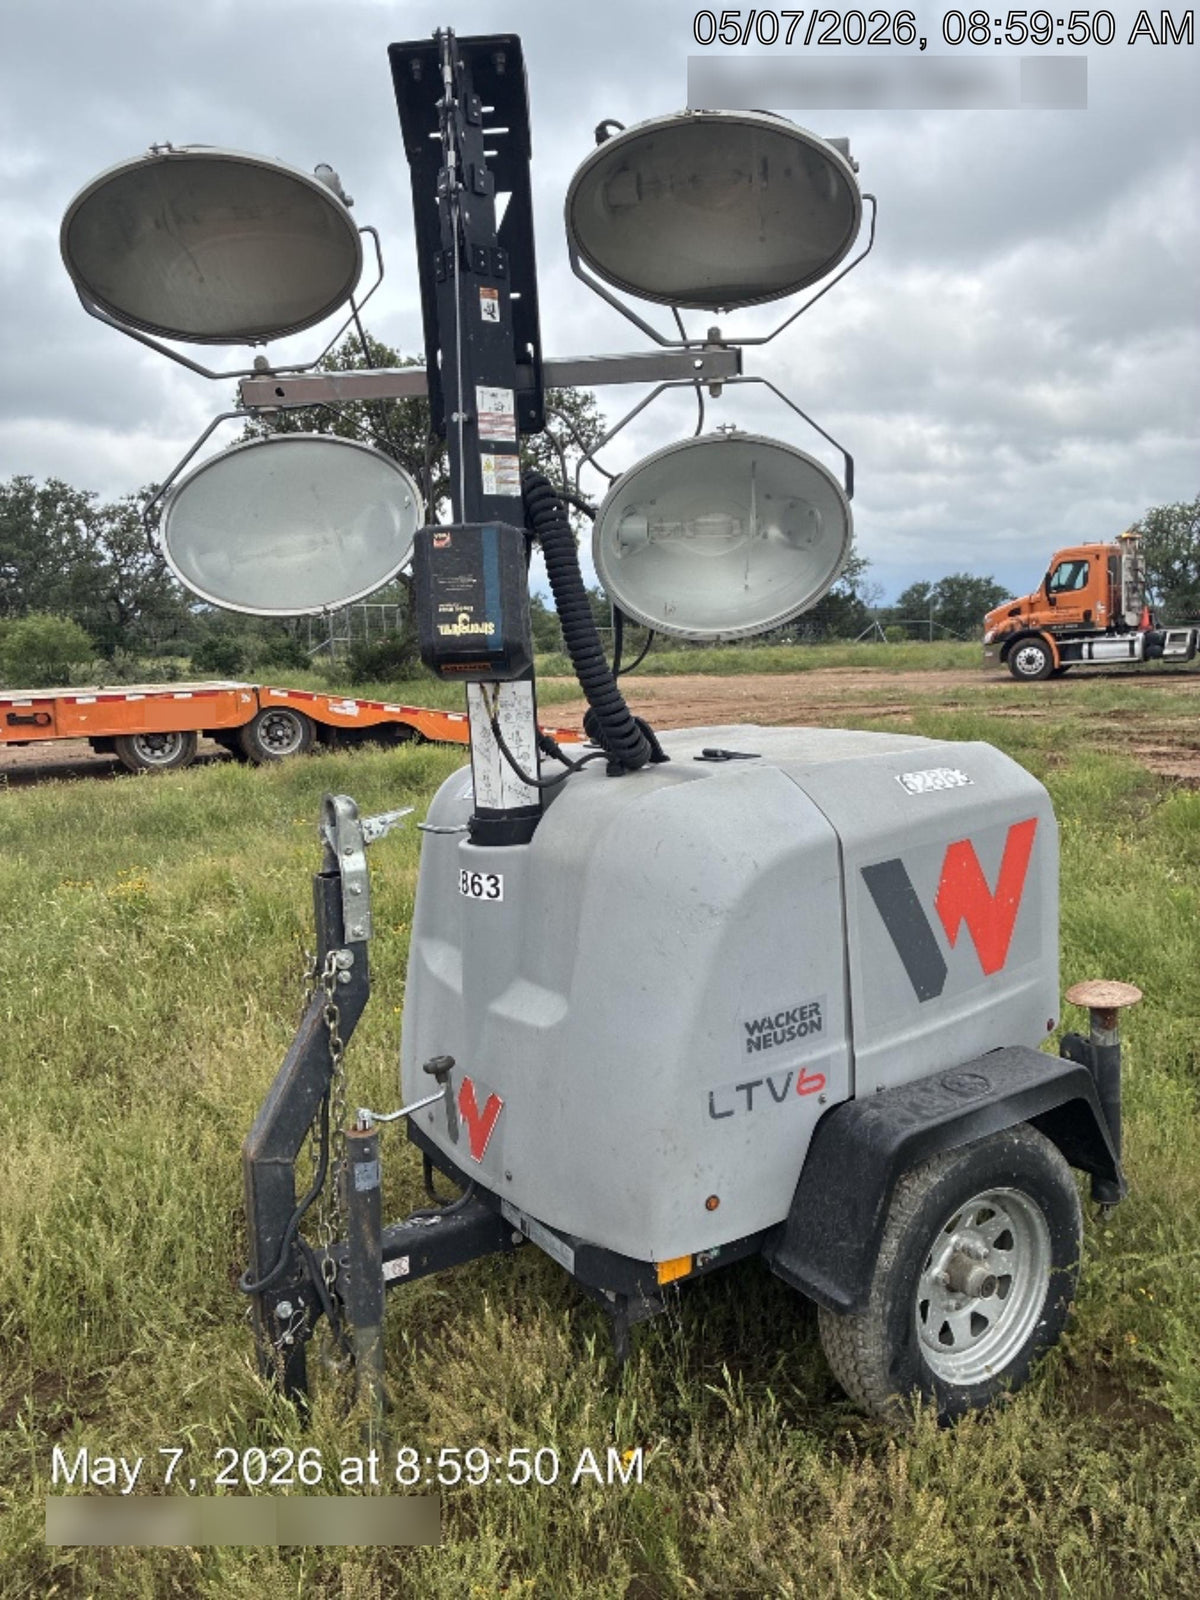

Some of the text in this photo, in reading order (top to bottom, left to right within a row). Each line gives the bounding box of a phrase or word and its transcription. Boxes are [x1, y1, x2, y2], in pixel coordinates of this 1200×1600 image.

[744, 1002, 821, 1036] WACKER
[746, 1017, 822, 1053] NEUSON
[708, 1067, 826, 1119] LTV6
